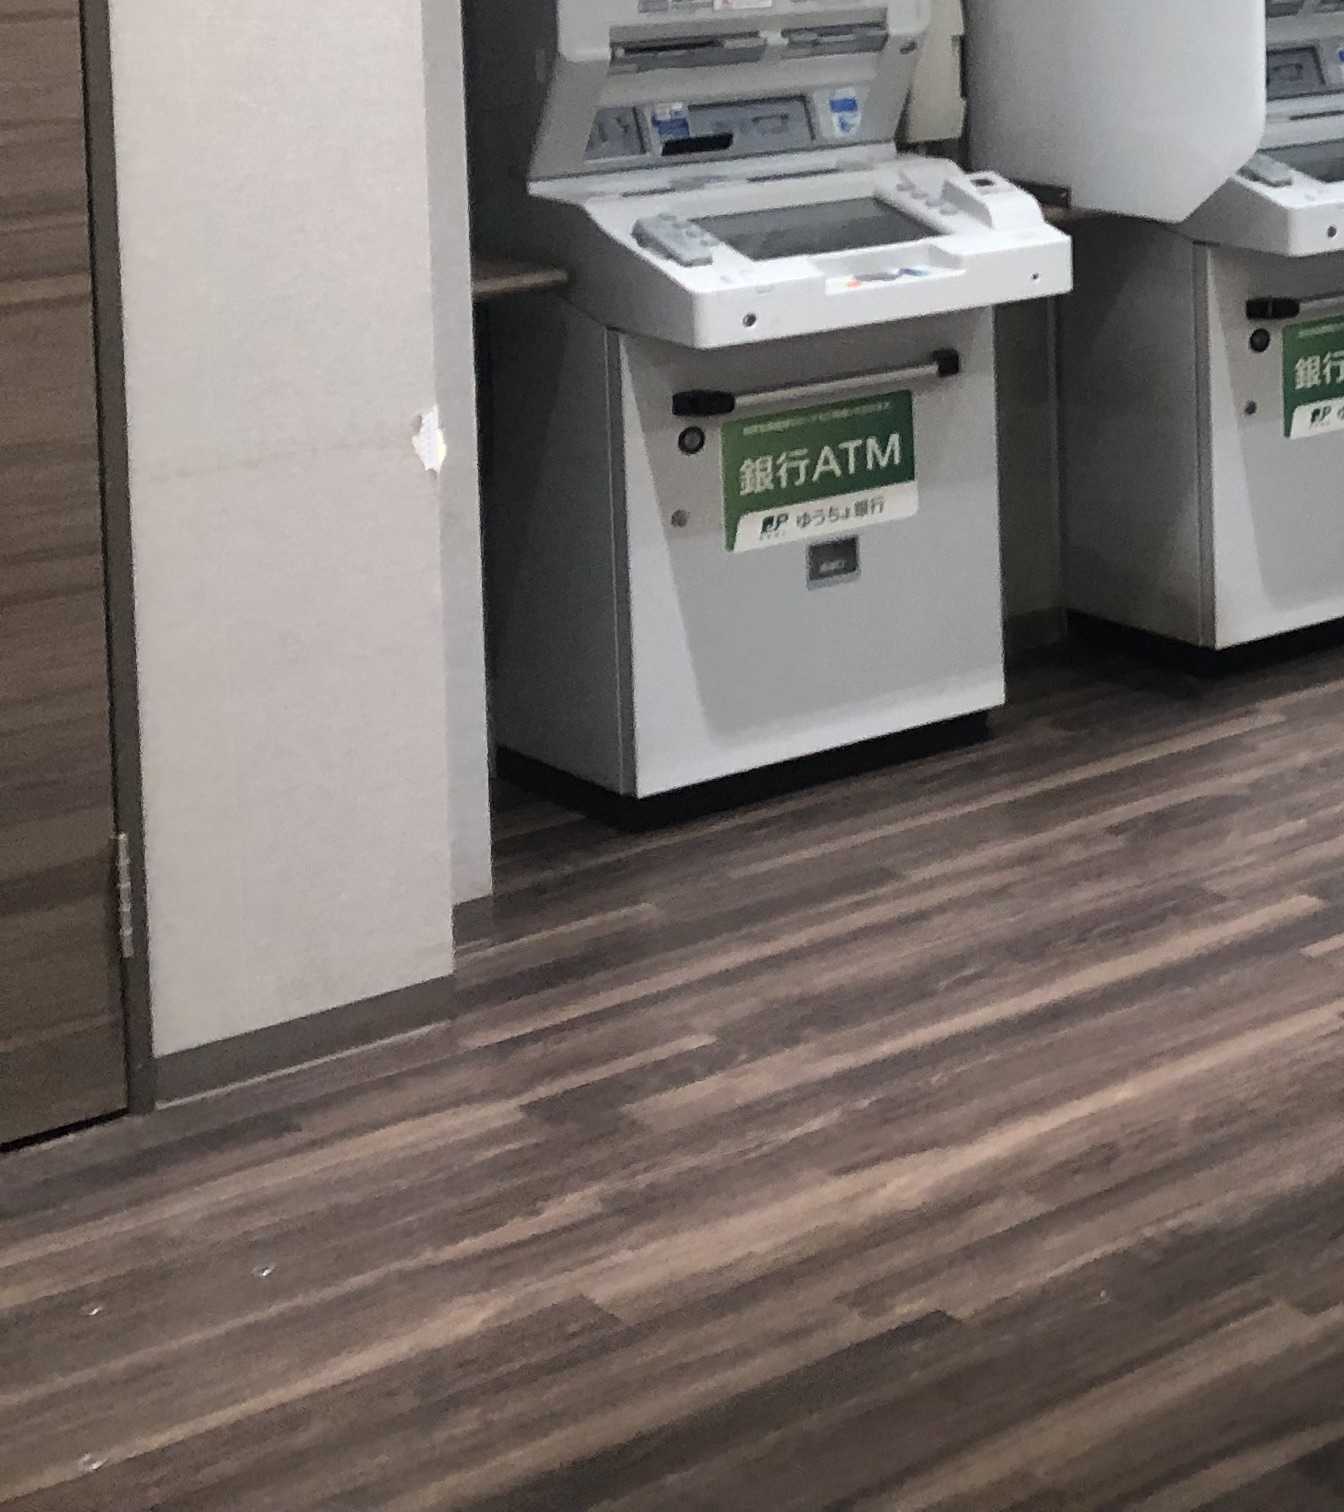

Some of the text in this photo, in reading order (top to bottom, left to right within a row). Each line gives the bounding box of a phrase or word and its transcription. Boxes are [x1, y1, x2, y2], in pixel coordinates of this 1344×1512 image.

[738, 433, 902, 496] 銀行ATM
[796, 496, 885, 529] ゆうちょ銀行
